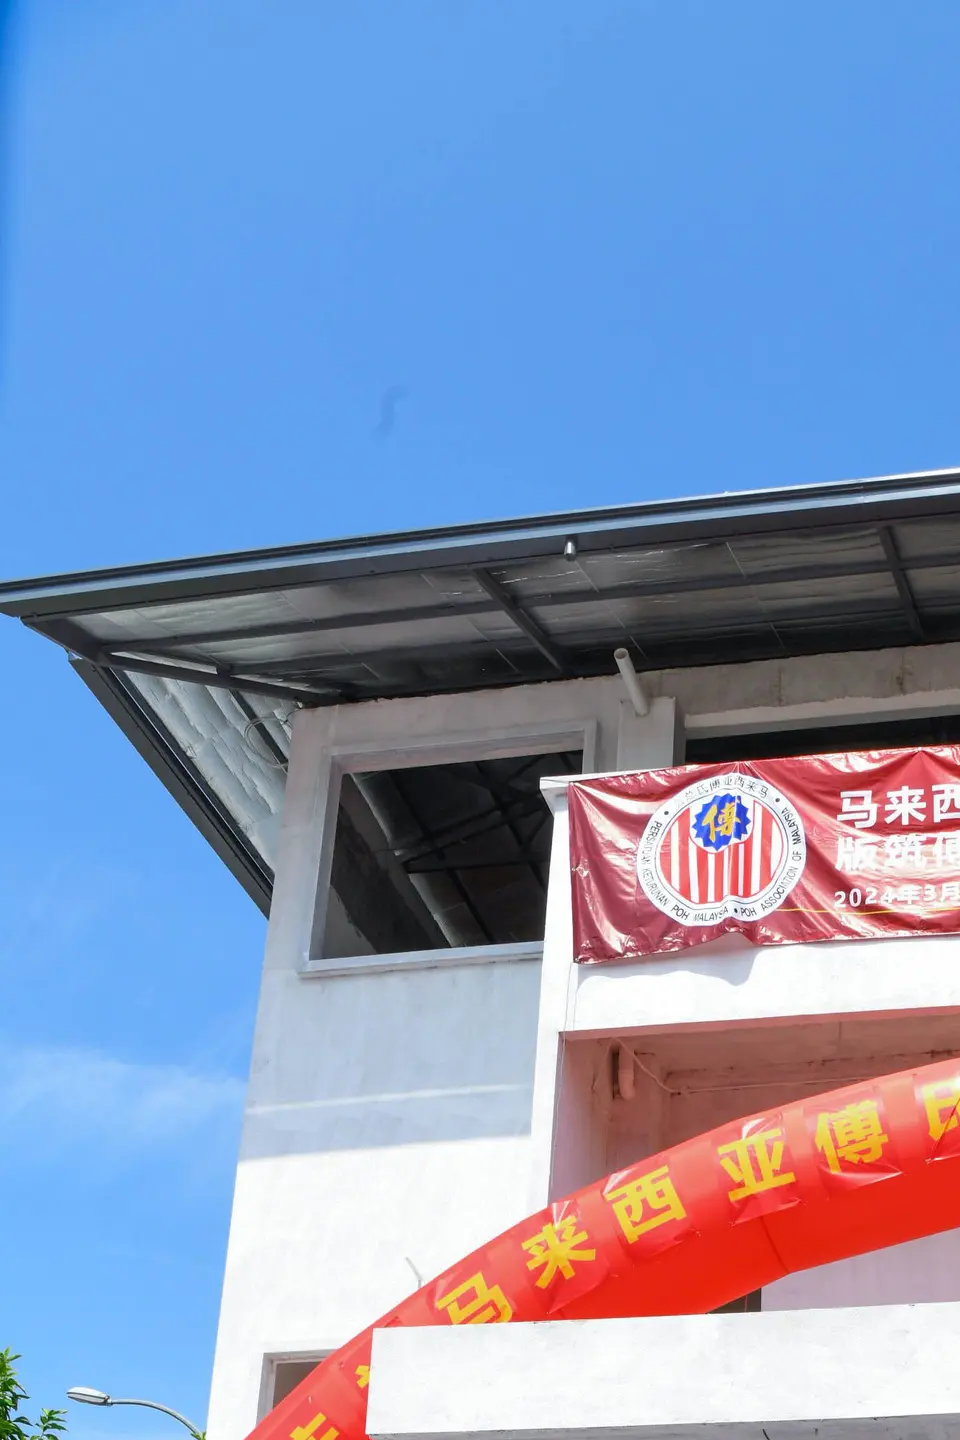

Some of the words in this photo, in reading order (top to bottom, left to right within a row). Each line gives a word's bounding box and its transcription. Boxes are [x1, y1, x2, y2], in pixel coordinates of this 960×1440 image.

[678, 776, 769, 807] 马来西亚傅氏总
[641, 820, 663, 865] PERSATUAN
[781, 807, 802, 845] MALAYSIA
[792, 850, 802, 861] OF
[642, 868, 670, 907] KETURUNAN
[760, 866, 798, 911] ASSOCIATION
[671, 904, 690, 920] POH
[740, 907, 757, 918] POH
